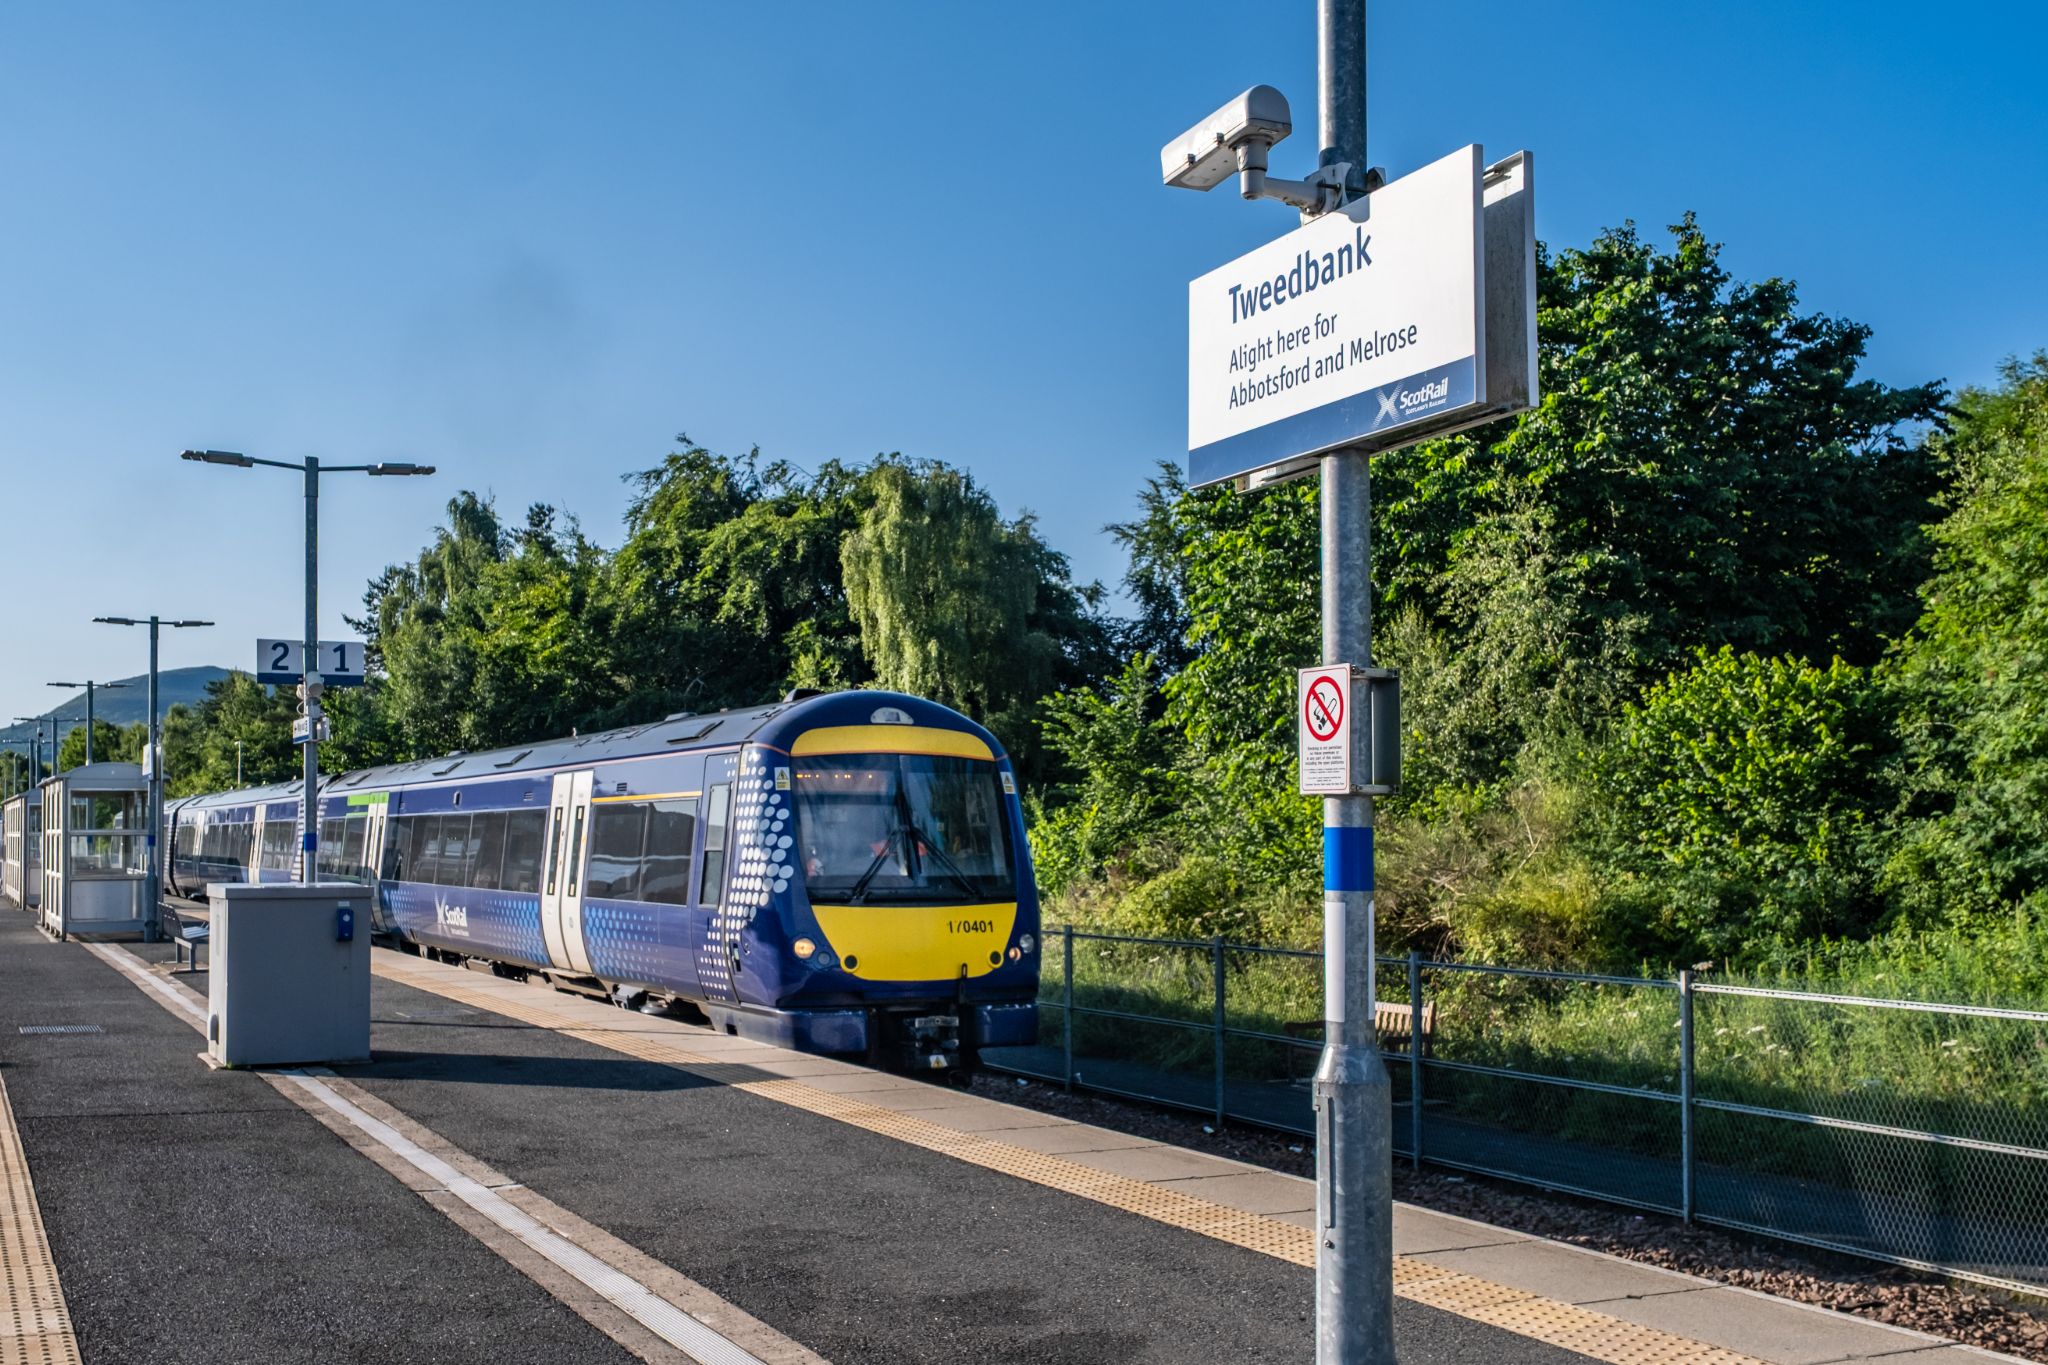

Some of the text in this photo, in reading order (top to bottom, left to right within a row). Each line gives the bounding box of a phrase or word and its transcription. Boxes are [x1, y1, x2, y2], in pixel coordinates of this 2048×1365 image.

[1228, 225, 1372, 324] Tweedbank
[1229, 313, 1338, 374] Alight here for
[1229, 324, 1417, 410] Abbotsford and Melrose
[1400, 377, 1448, 409] ScotRail
[271, 642, 289, 670] 2
[333, 644, 350, 672] 1
